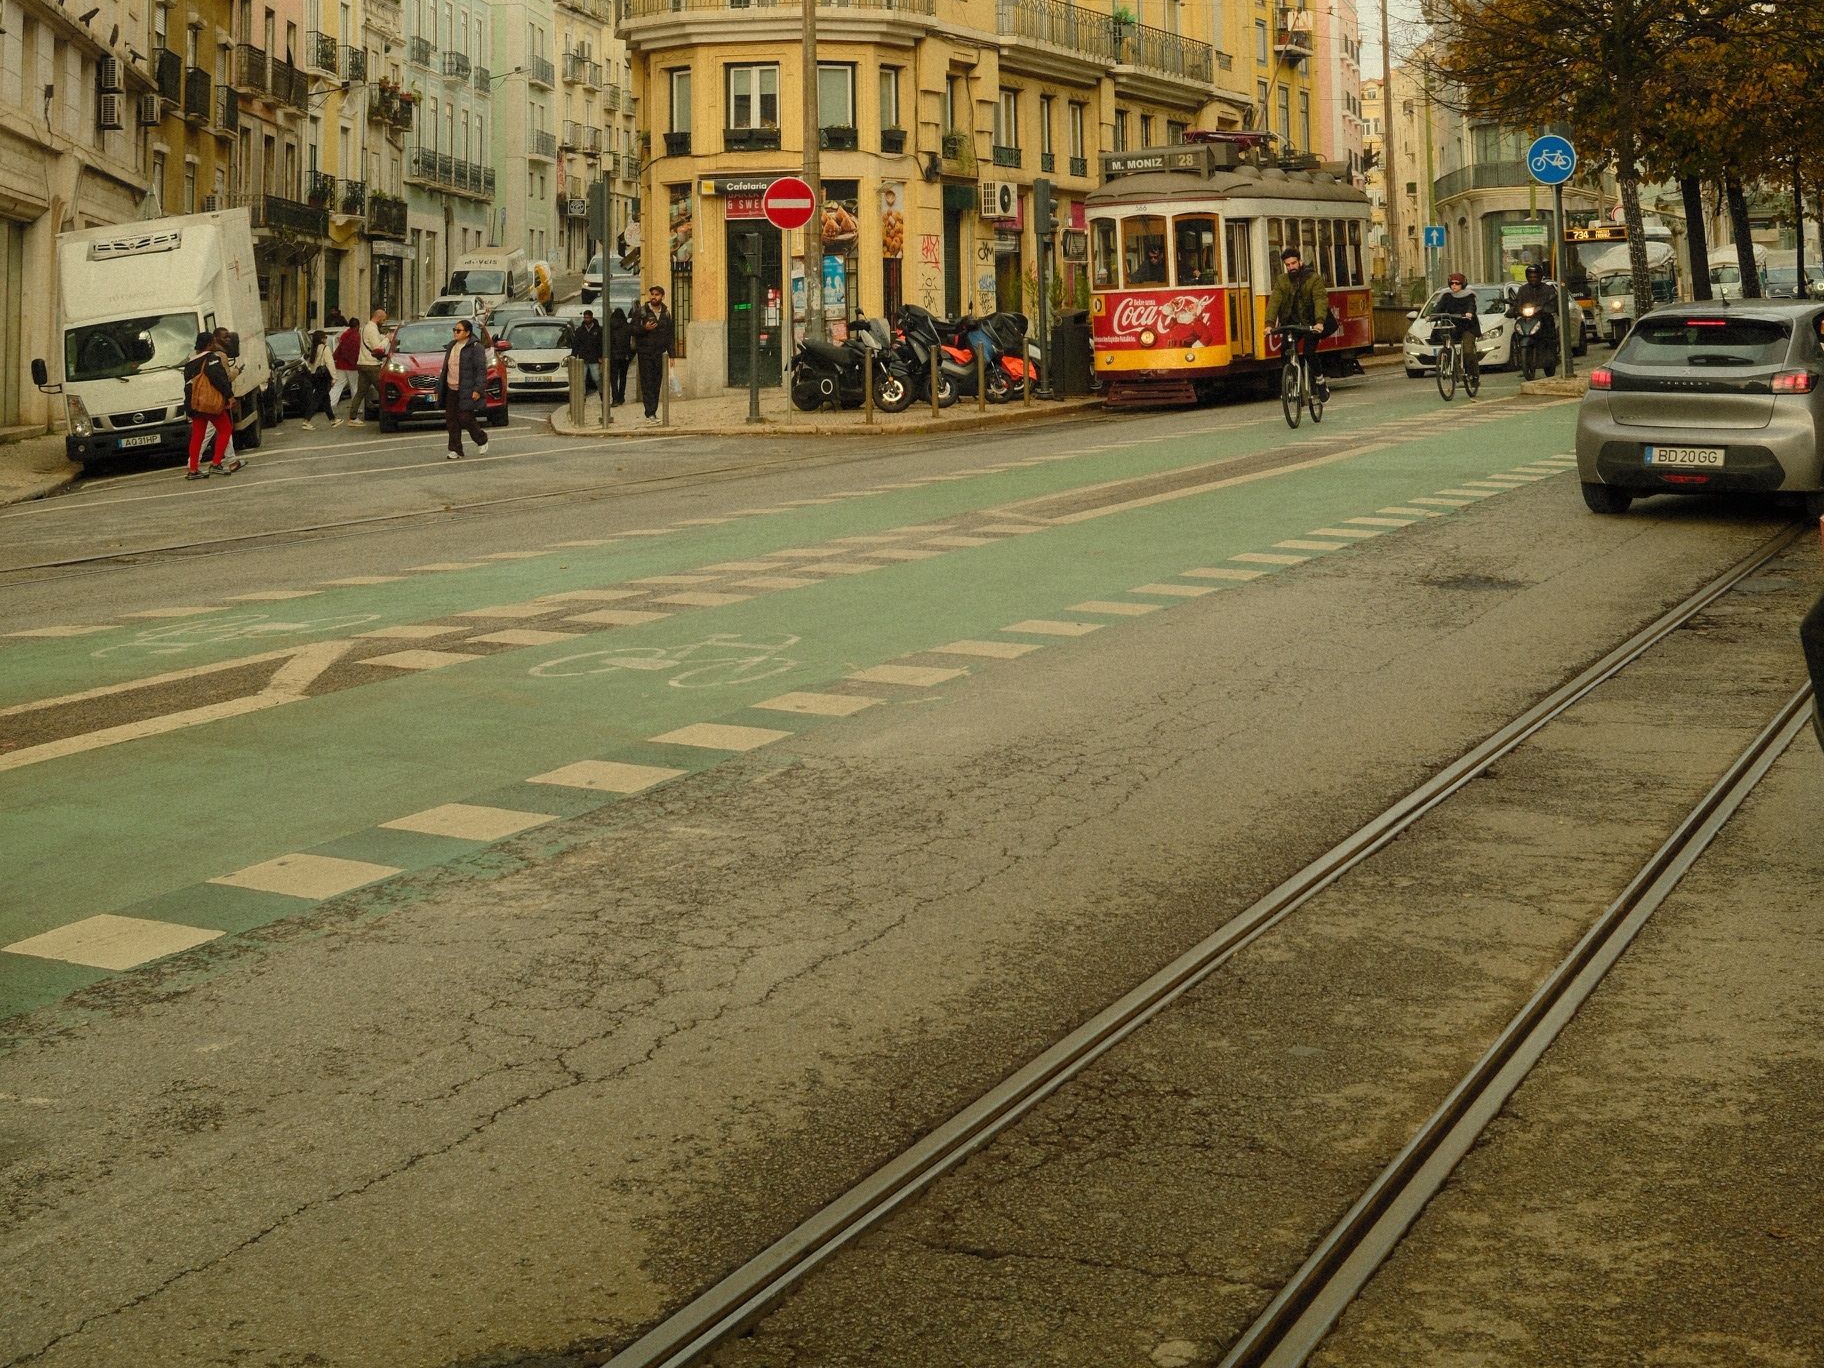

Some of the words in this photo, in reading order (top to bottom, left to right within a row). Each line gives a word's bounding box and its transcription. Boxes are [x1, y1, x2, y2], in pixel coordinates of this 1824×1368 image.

[1112, 161, 1124, 170] M.
[1127, 158, 1163, 169] MONIZ
[1178, 154, 1194, 166] 28
[738, 198, 763, 209] SWE
[1573, 231, 1589, 239] 734
